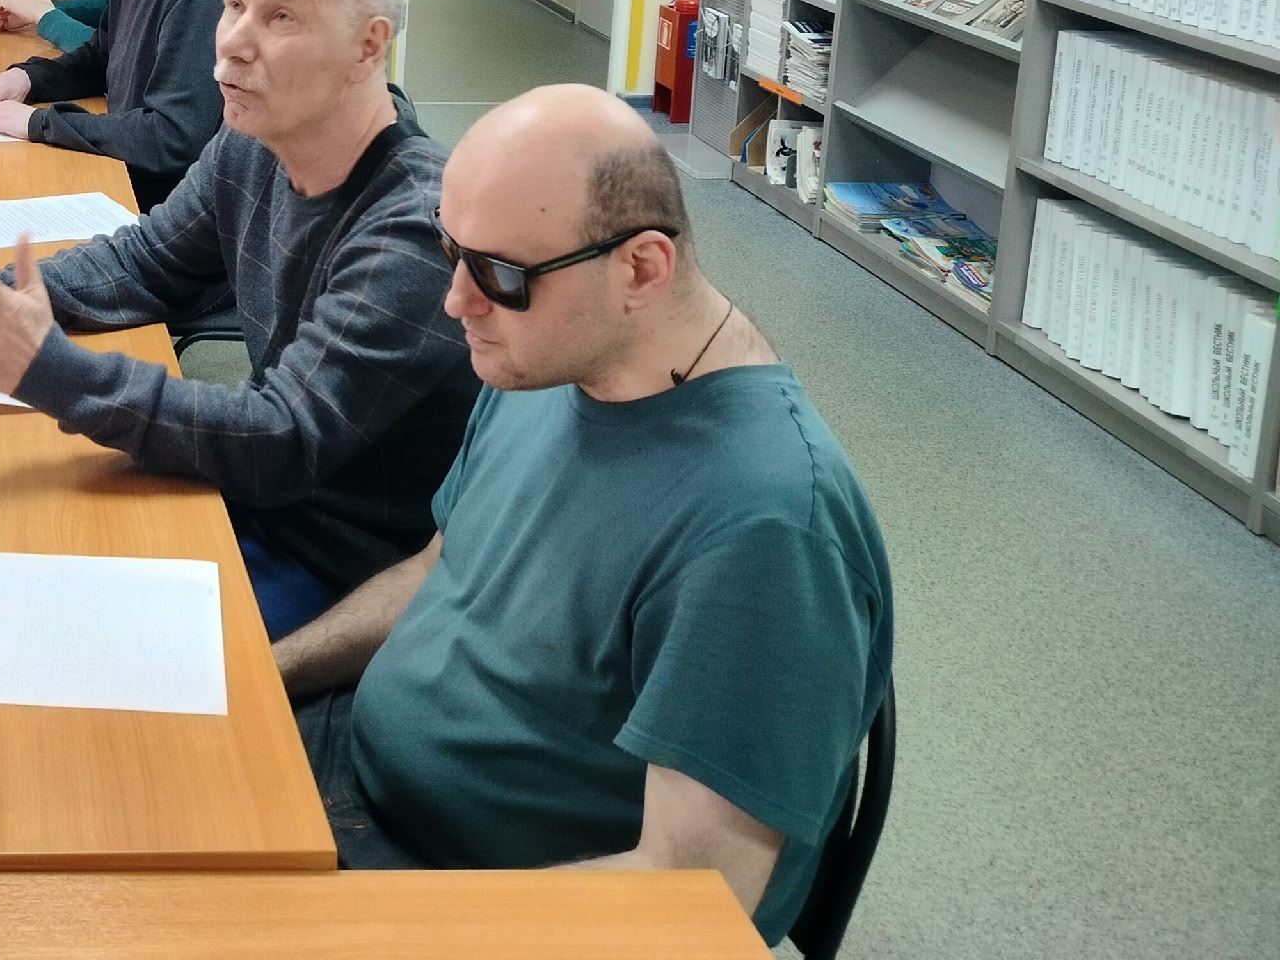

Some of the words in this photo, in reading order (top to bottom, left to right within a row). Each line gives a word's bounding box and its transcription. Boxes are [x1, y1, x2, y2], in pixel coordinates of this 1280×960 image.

[1213, 322, 1223, 355] ВЕСТНИК
[1226, 329, 1236, 363] ВЕСТНИК
[1211, 358, 1221, 400] ШКОЛЬНЫЙ
[1223, 365, 1232, 408] ШКОЛЬНЫЙ
[1236, 387, 1246, 430] ШКОЛЬНЫЙ
[1242, 352, 1251, 386] ВЕСТНИК
[1246, 396, 1256, 439] ШКОЛЬНЫЙ
[1251, 359, 1261, 394] ВЕСТНИК
